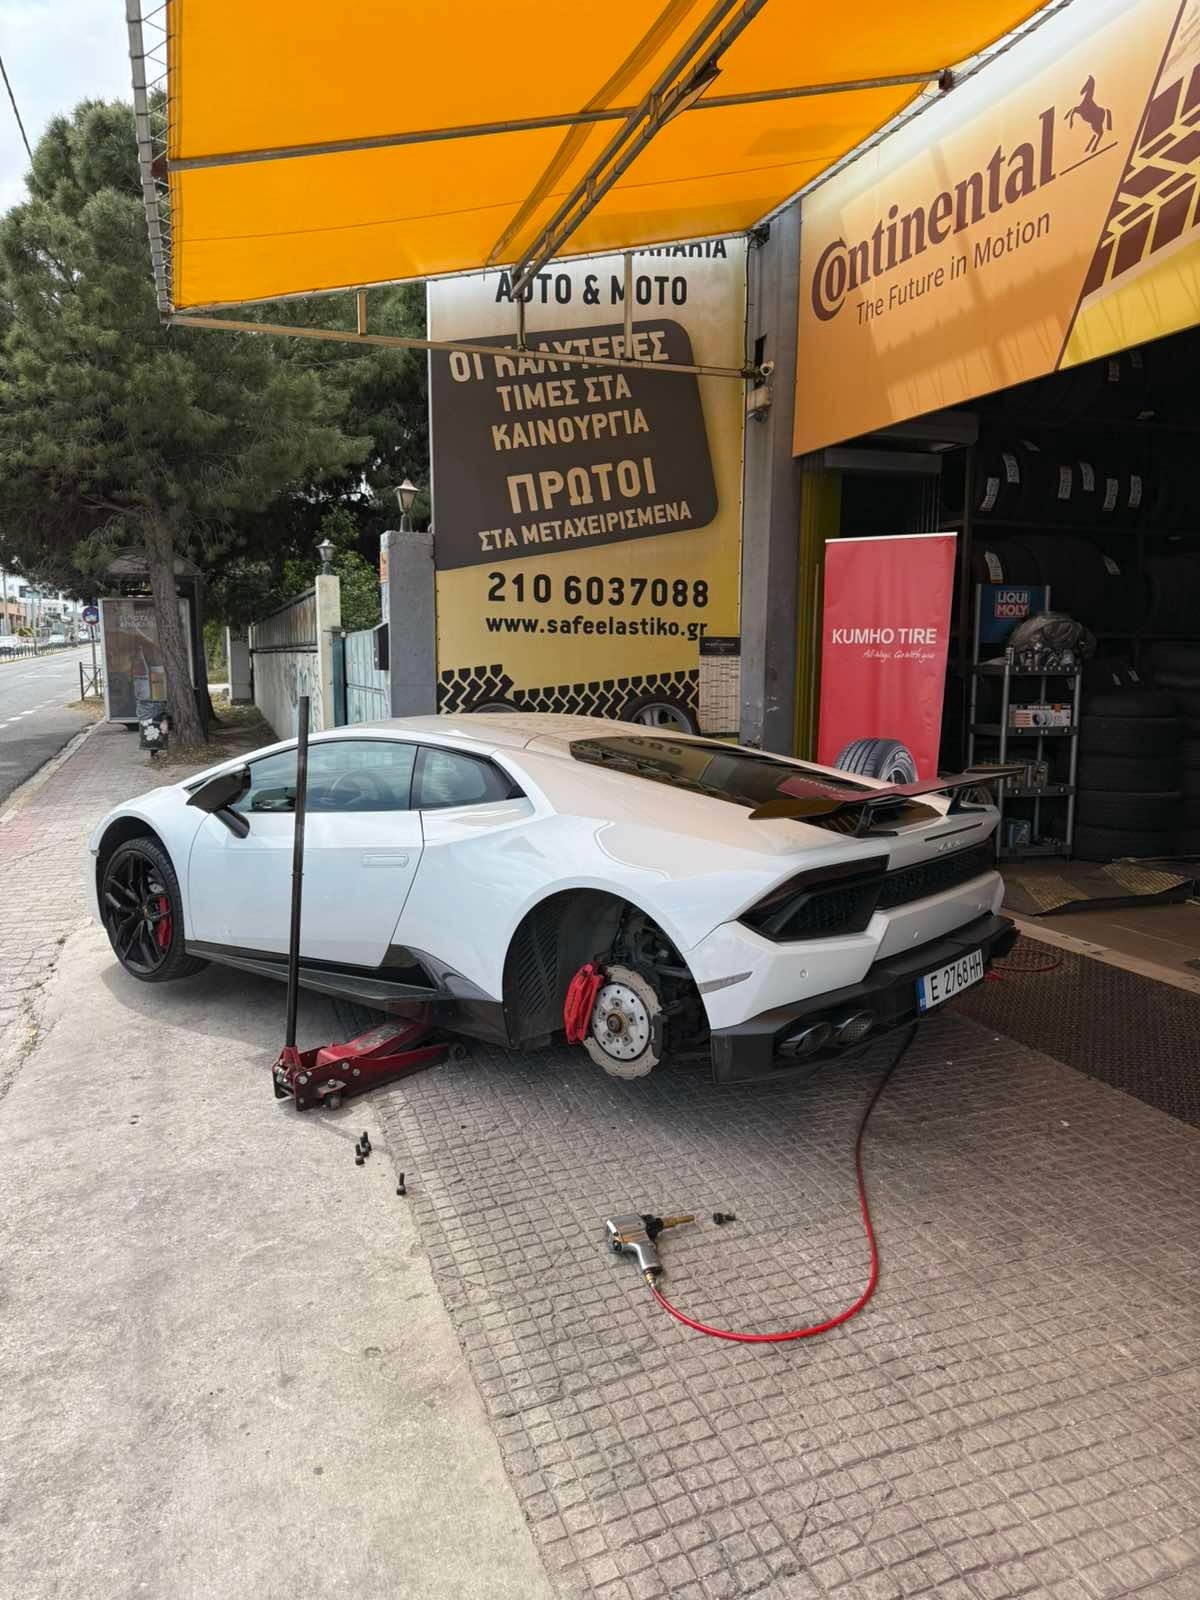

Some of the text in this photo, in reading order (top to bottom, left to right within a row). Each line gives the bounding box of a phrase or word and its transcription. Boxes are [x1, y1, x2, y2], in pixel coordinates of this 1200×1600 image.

[811, 106, 1056, 321] Continental
[856, 212, 1051, 325] The Future in Motion
[583, 274, 600, 305] &
[610, 274, 687, 305] MOTO
[449, 351, 484, 383] ΟΙ
[496, 373, 632, 412] ΤΙΜΕΣ ΣΤΑ
[491, 408, 650, 451] ΚΑΙΝΟΥΡΓΙΑ
[506, 457, 657, 514] ΠΡΩΤΟΙ
[478, 500, 693, 552] ΣΤΑ ΜΕΤΑΧΕΙΡΙΣΜΕΝΑ
[487, 571, 709, 608] 210 6037088
[997, 591, 1029, 604] LIQUI
[996, 604, 1028, 616] MOLY
[486, 616, 708, 641] www.safeelastiko.gr
[831, 628, 937, 644] KUMHO TIRE
[930, 975, 940, 1001] E
